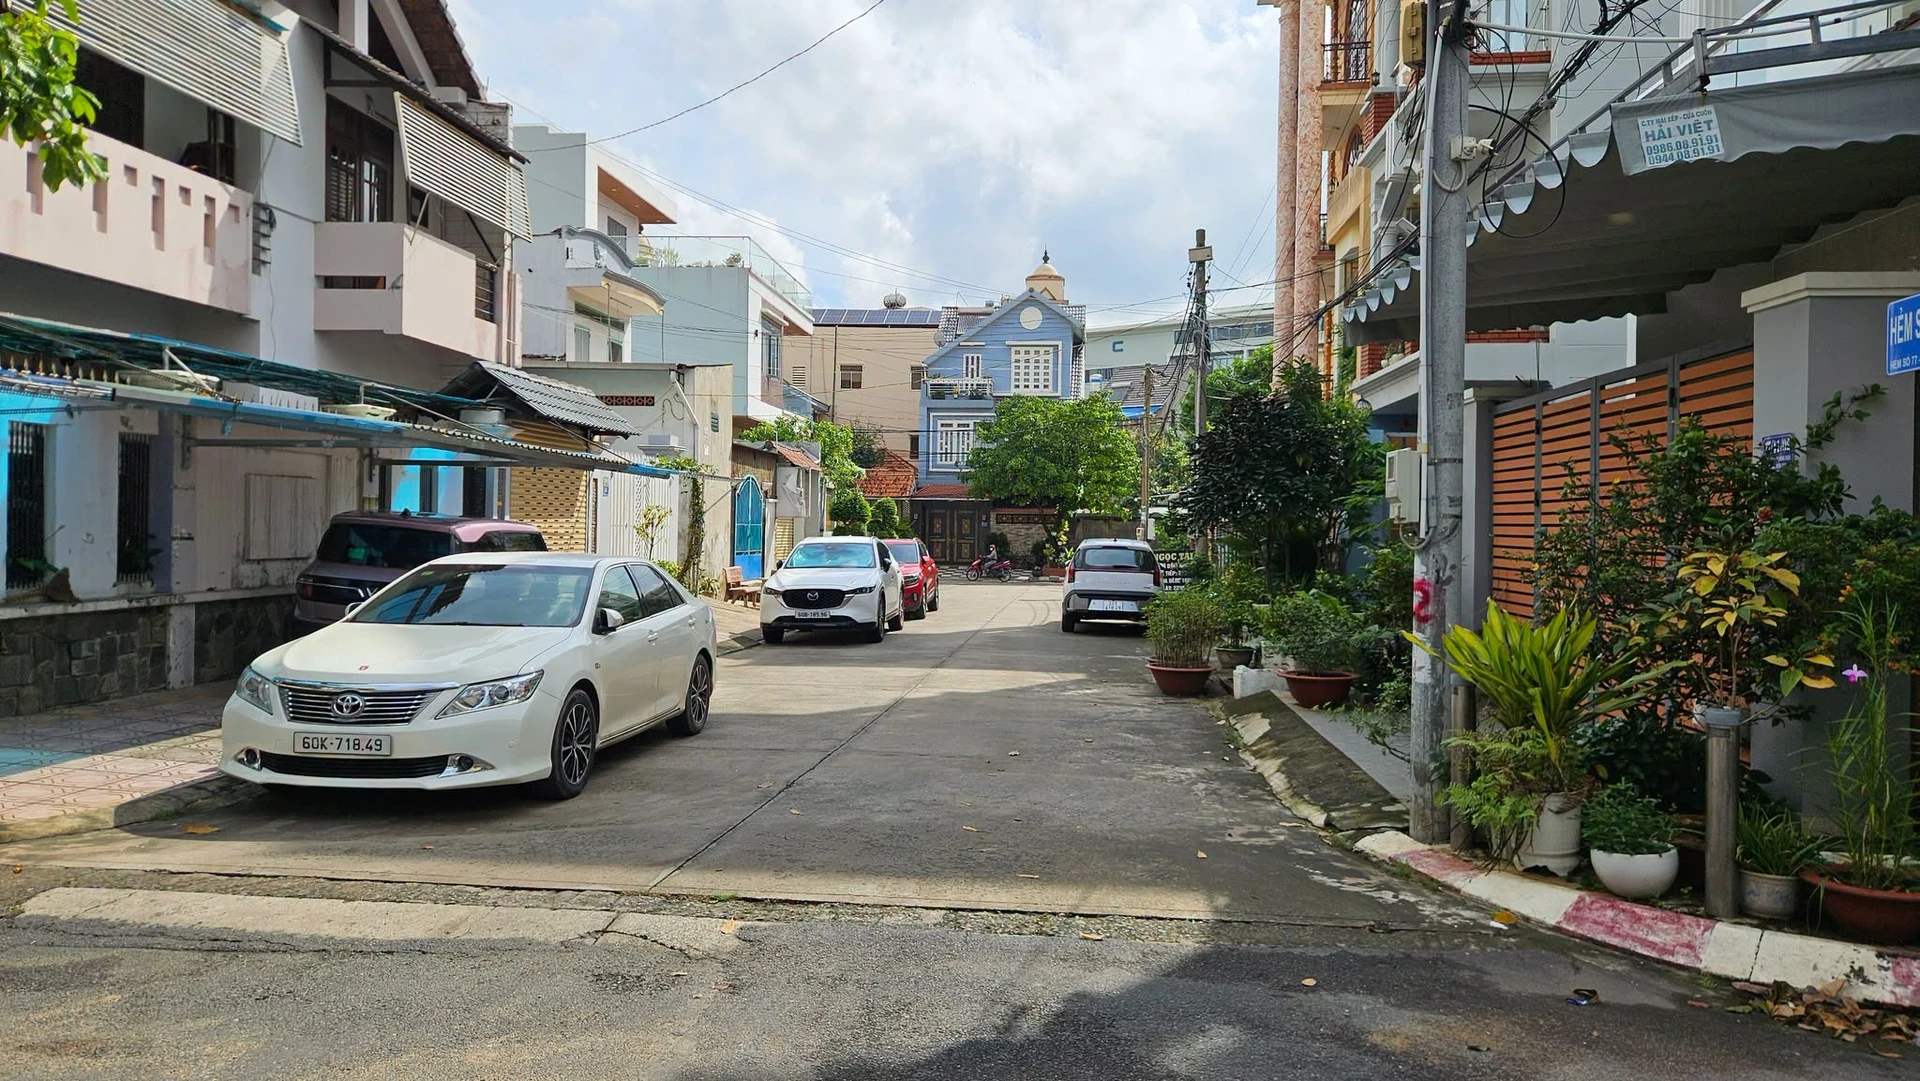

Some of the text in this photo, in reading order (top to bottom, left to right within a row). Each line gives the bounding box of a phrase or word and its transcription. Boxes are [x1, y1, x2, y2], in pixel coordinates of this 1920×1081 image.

[1644, 119, 1713, 142] HẢI VIỆT
[1646, 134, 1719, 156] 0986.08.91.91
[1648, 144, 1720, 165] 0944.08.91.91
[1890, 307, 1913, 346] HẺM
[302, 736, 383, 752] 60K-718.49
